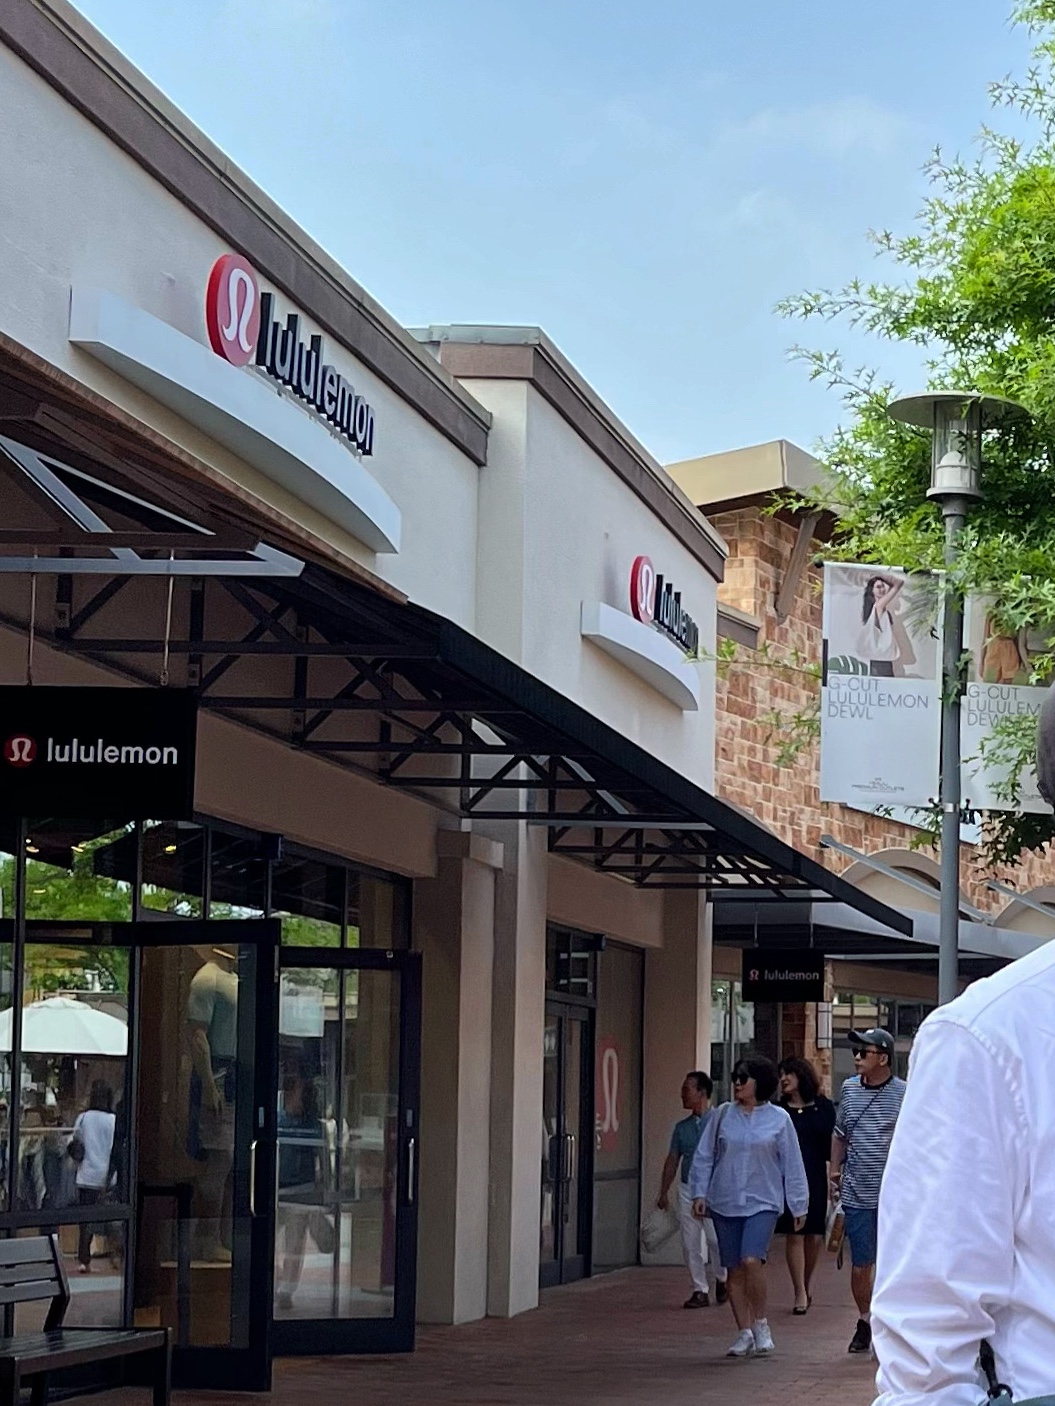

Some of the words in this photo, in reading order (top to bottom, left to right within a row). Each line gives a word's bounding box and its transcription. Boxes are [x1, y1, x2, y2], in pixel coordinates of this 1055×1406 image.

[256, 292, 375, 456] lululemon
[828, 676, 881, 692] G-CUT
[828, 690, 929, 709] LULULEMON
[968, 684, 1021, 701] G-CUT
[828, 704, 874, 720] DEWL
[968, 700, 1041, 715] LULULEM
[47, 737, 178, 765] lululemon
[764, 969, 820, 980] lululemon
